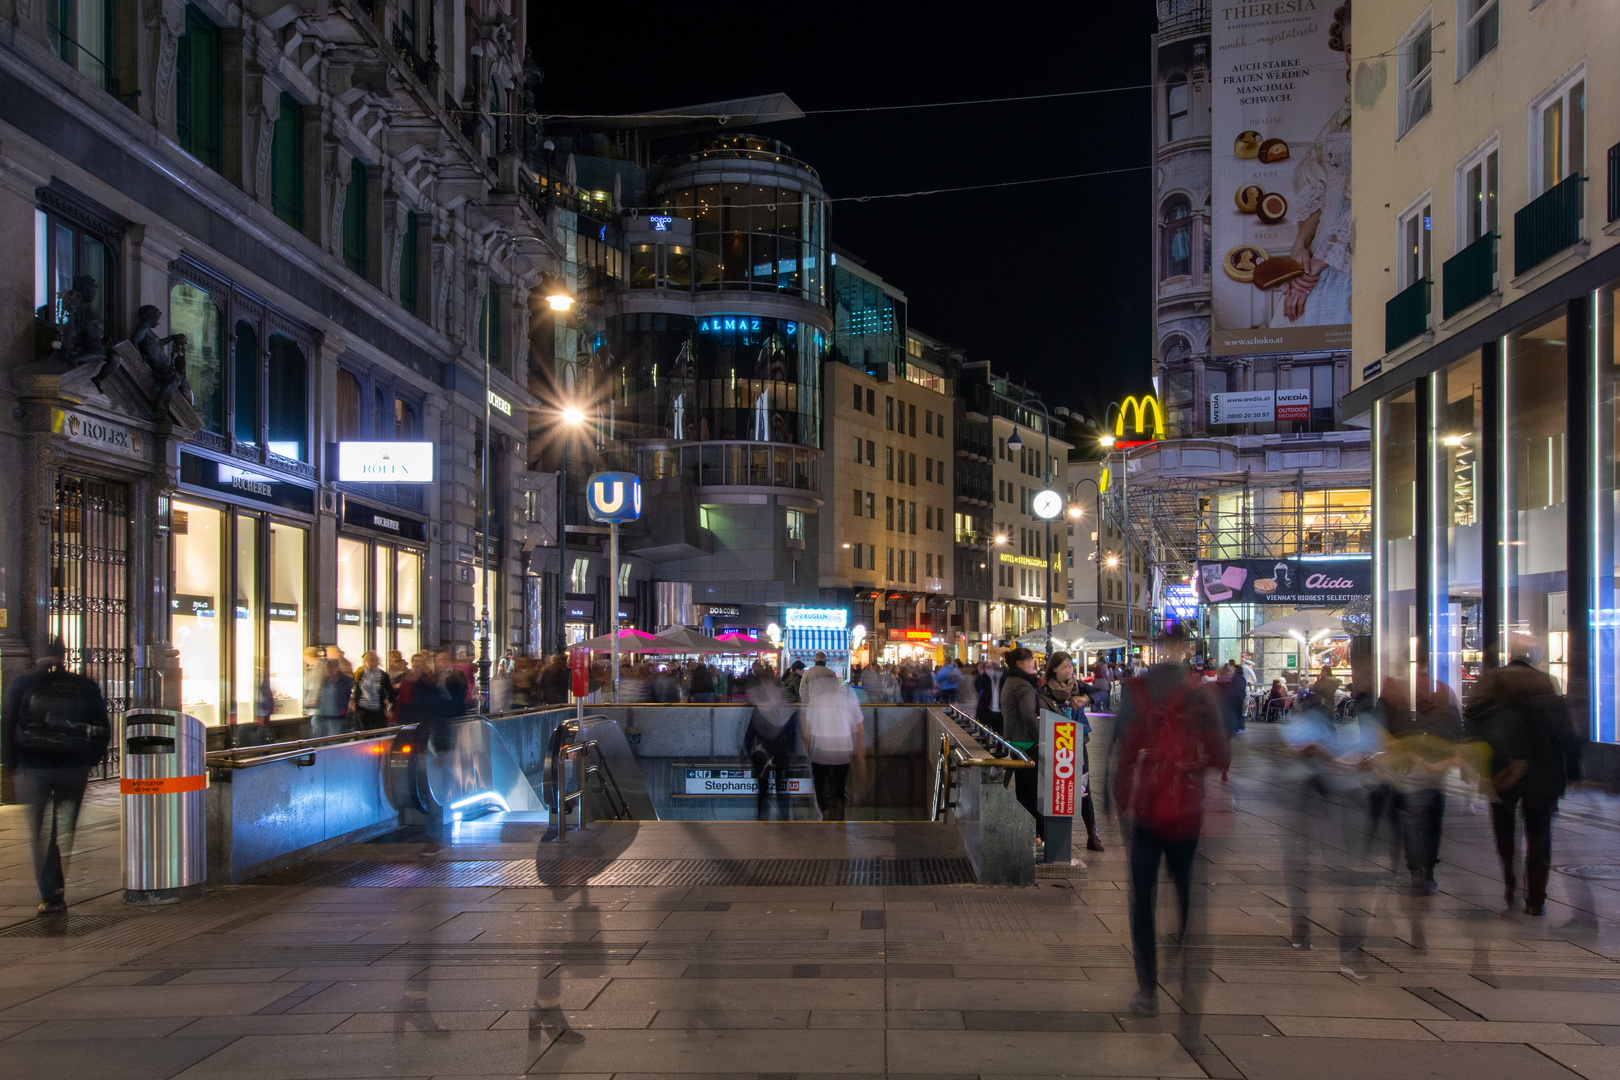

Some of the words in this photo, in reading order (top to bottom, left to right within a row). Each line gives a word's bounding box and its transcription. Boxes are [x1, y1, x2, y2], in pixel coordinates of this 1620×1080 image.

[1221, 0, 1316, 21] THERESIA
[1232, 61, 1261, 73] AUCH
[1262, 58, 1301, 70] STARKE
[1223, 73, 1263, 85] FRAUEN
[1266, 69, 1310, 81] WERDEN
[1236, 82, 1296, 95] MANCHMAL
[1239, 94, 1293, 105] SCHWACH.
[1249, 116, 1283, 126] PRALINE
[1253, 170, 1279, 179] KUGEL
[1254, 232, 1279, 240] TALER
[701, 320, 760, 331] ALMAZ
[1224, 336, 1283, 347] www.schoko.at
[488, 390, 512, 417] UCHERER
[1227, 394, 1271, 404] www.wedia.at
[1278, 406, 1308, 414] OUTDOOR
[82, 420, 129, 448] ROLEX
[231, 476, 273, 498] BUCHERER
[594, 481, 624, 514] U
[1056, 723, 1074, 778] oe24
